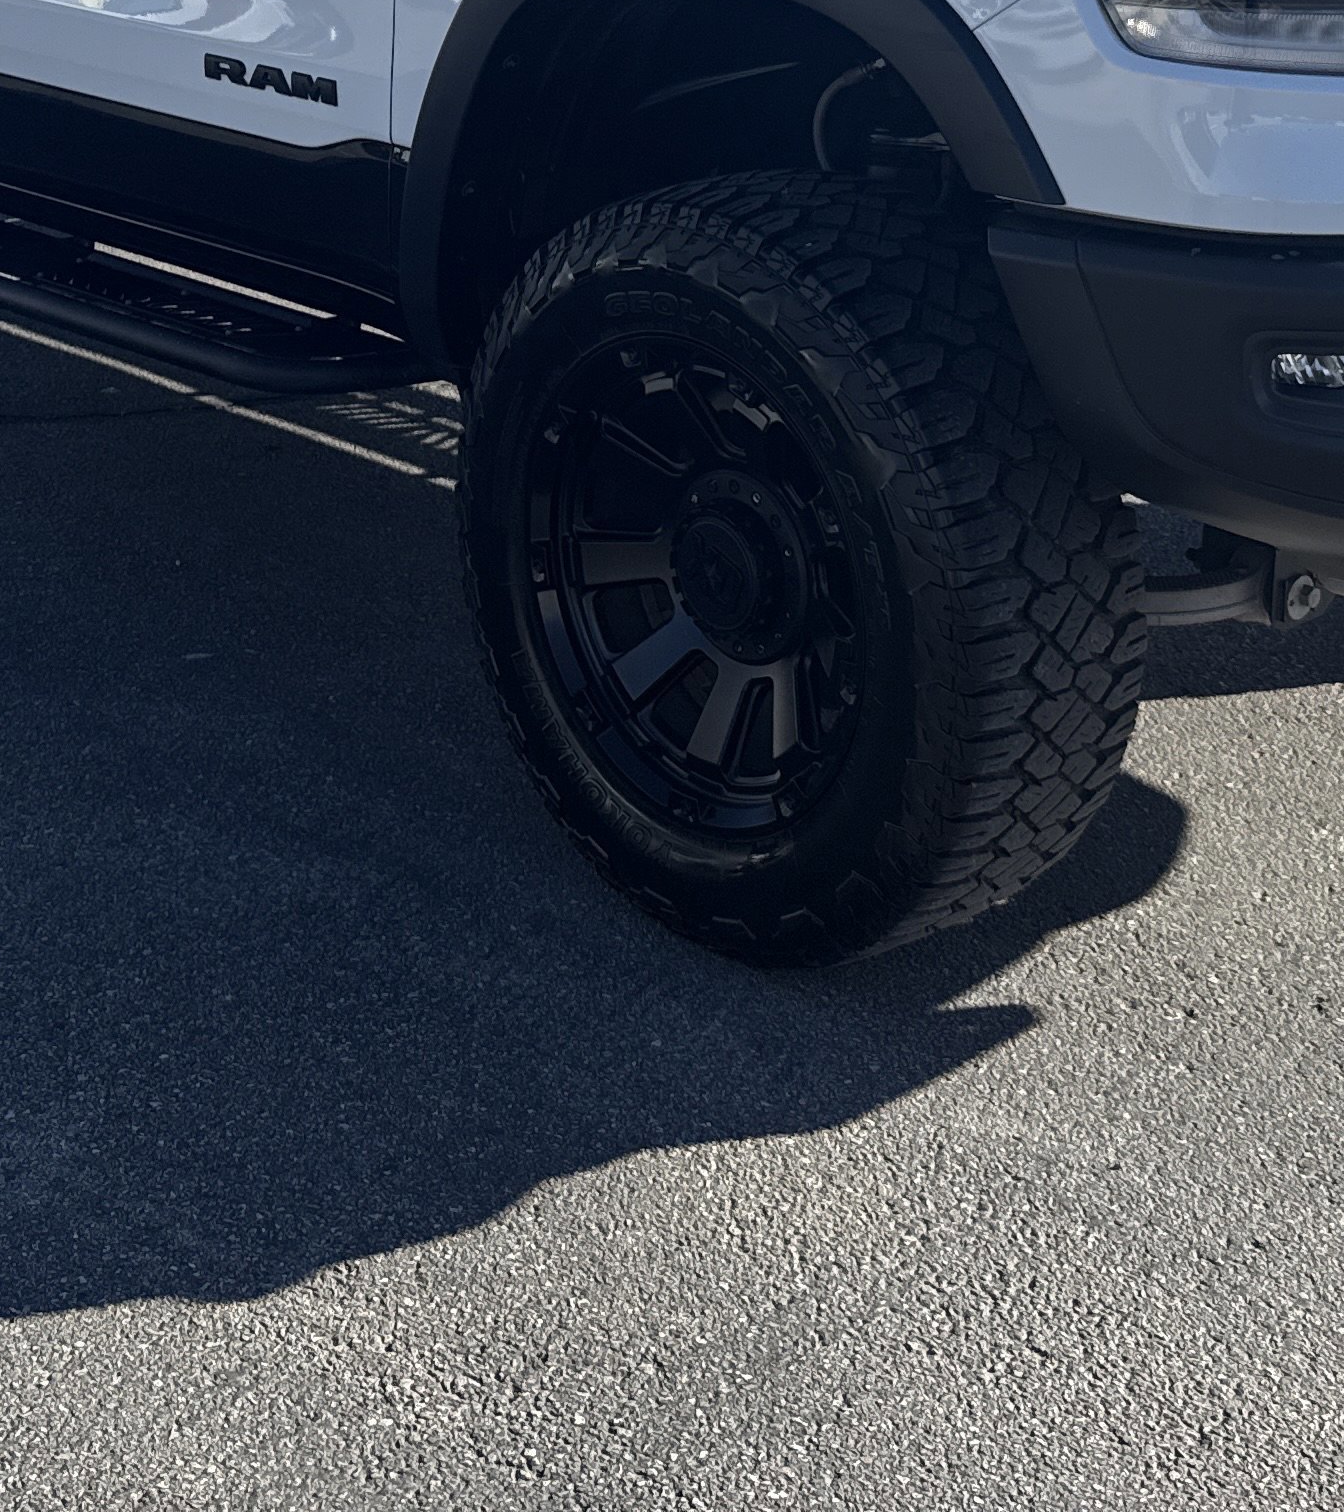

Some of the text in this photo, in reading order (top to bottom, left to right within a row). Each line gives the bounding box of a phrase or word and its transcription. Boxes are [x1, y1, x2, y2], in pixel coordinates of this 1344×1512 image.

[204, 52, 339, 107] RAM
[603, 290, 838, 451] GEOLANDAR
[509, 649, 673, 865] YOKOHAMA
